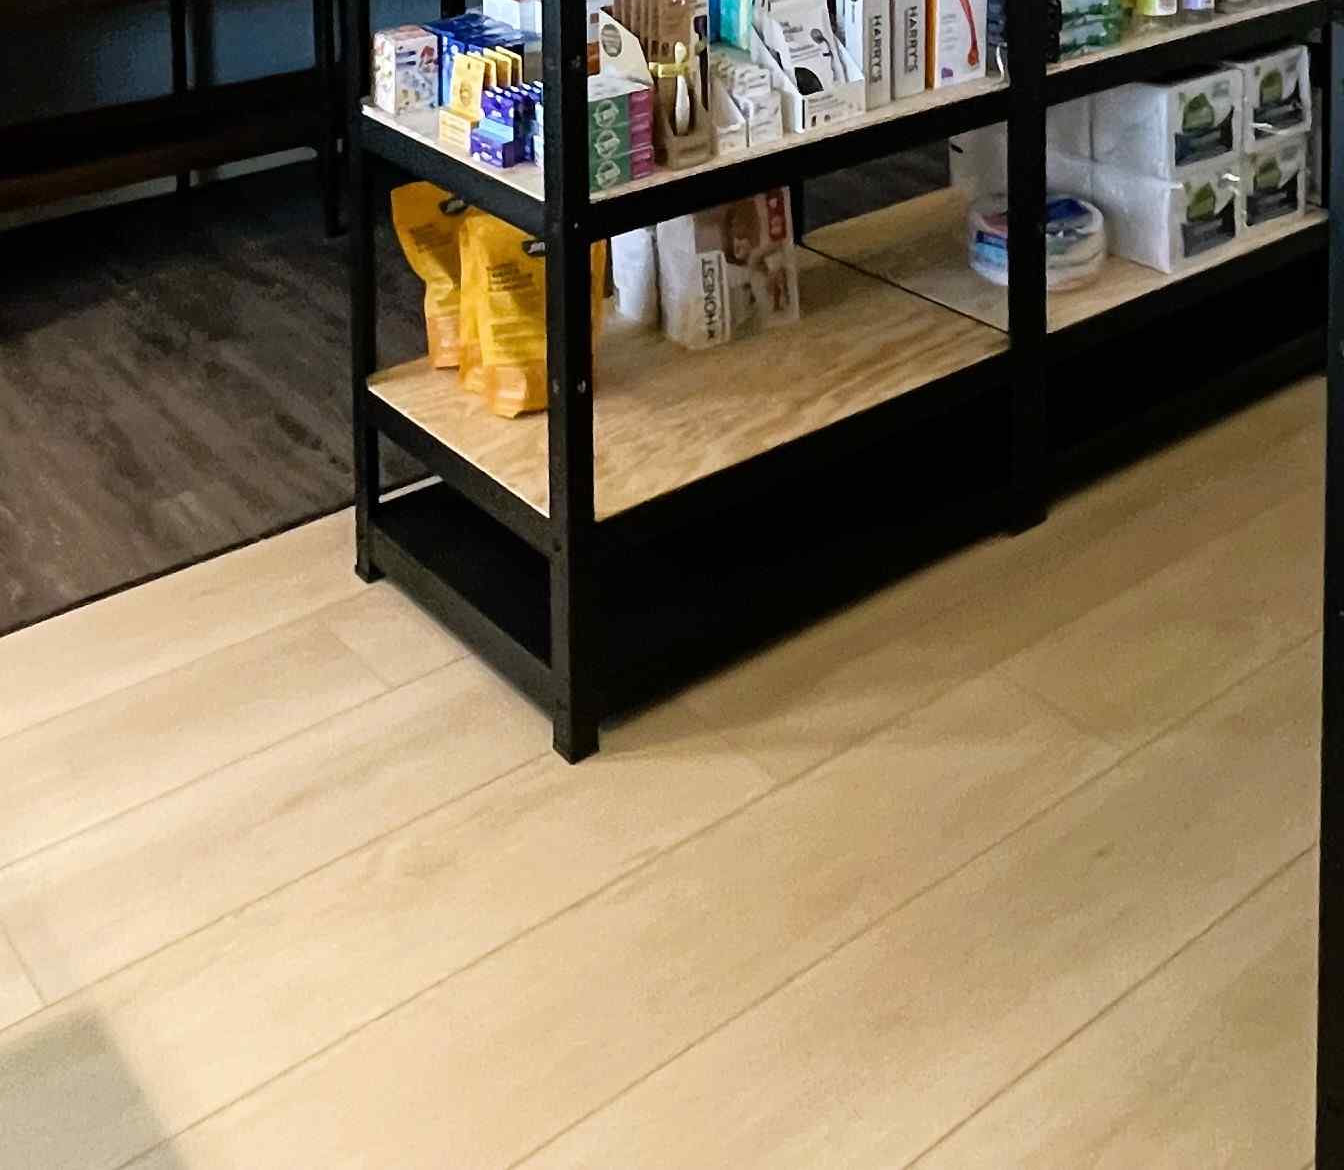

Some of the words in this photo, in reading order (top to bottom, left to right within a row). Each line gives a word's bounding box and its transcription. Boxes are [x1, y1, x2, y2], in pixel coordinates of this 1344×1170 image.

[871, 14, 882, 84] HARRY'S
[907, 5, 919, 73] HARRY'S
[701, 257, 719, 327] HONEST
